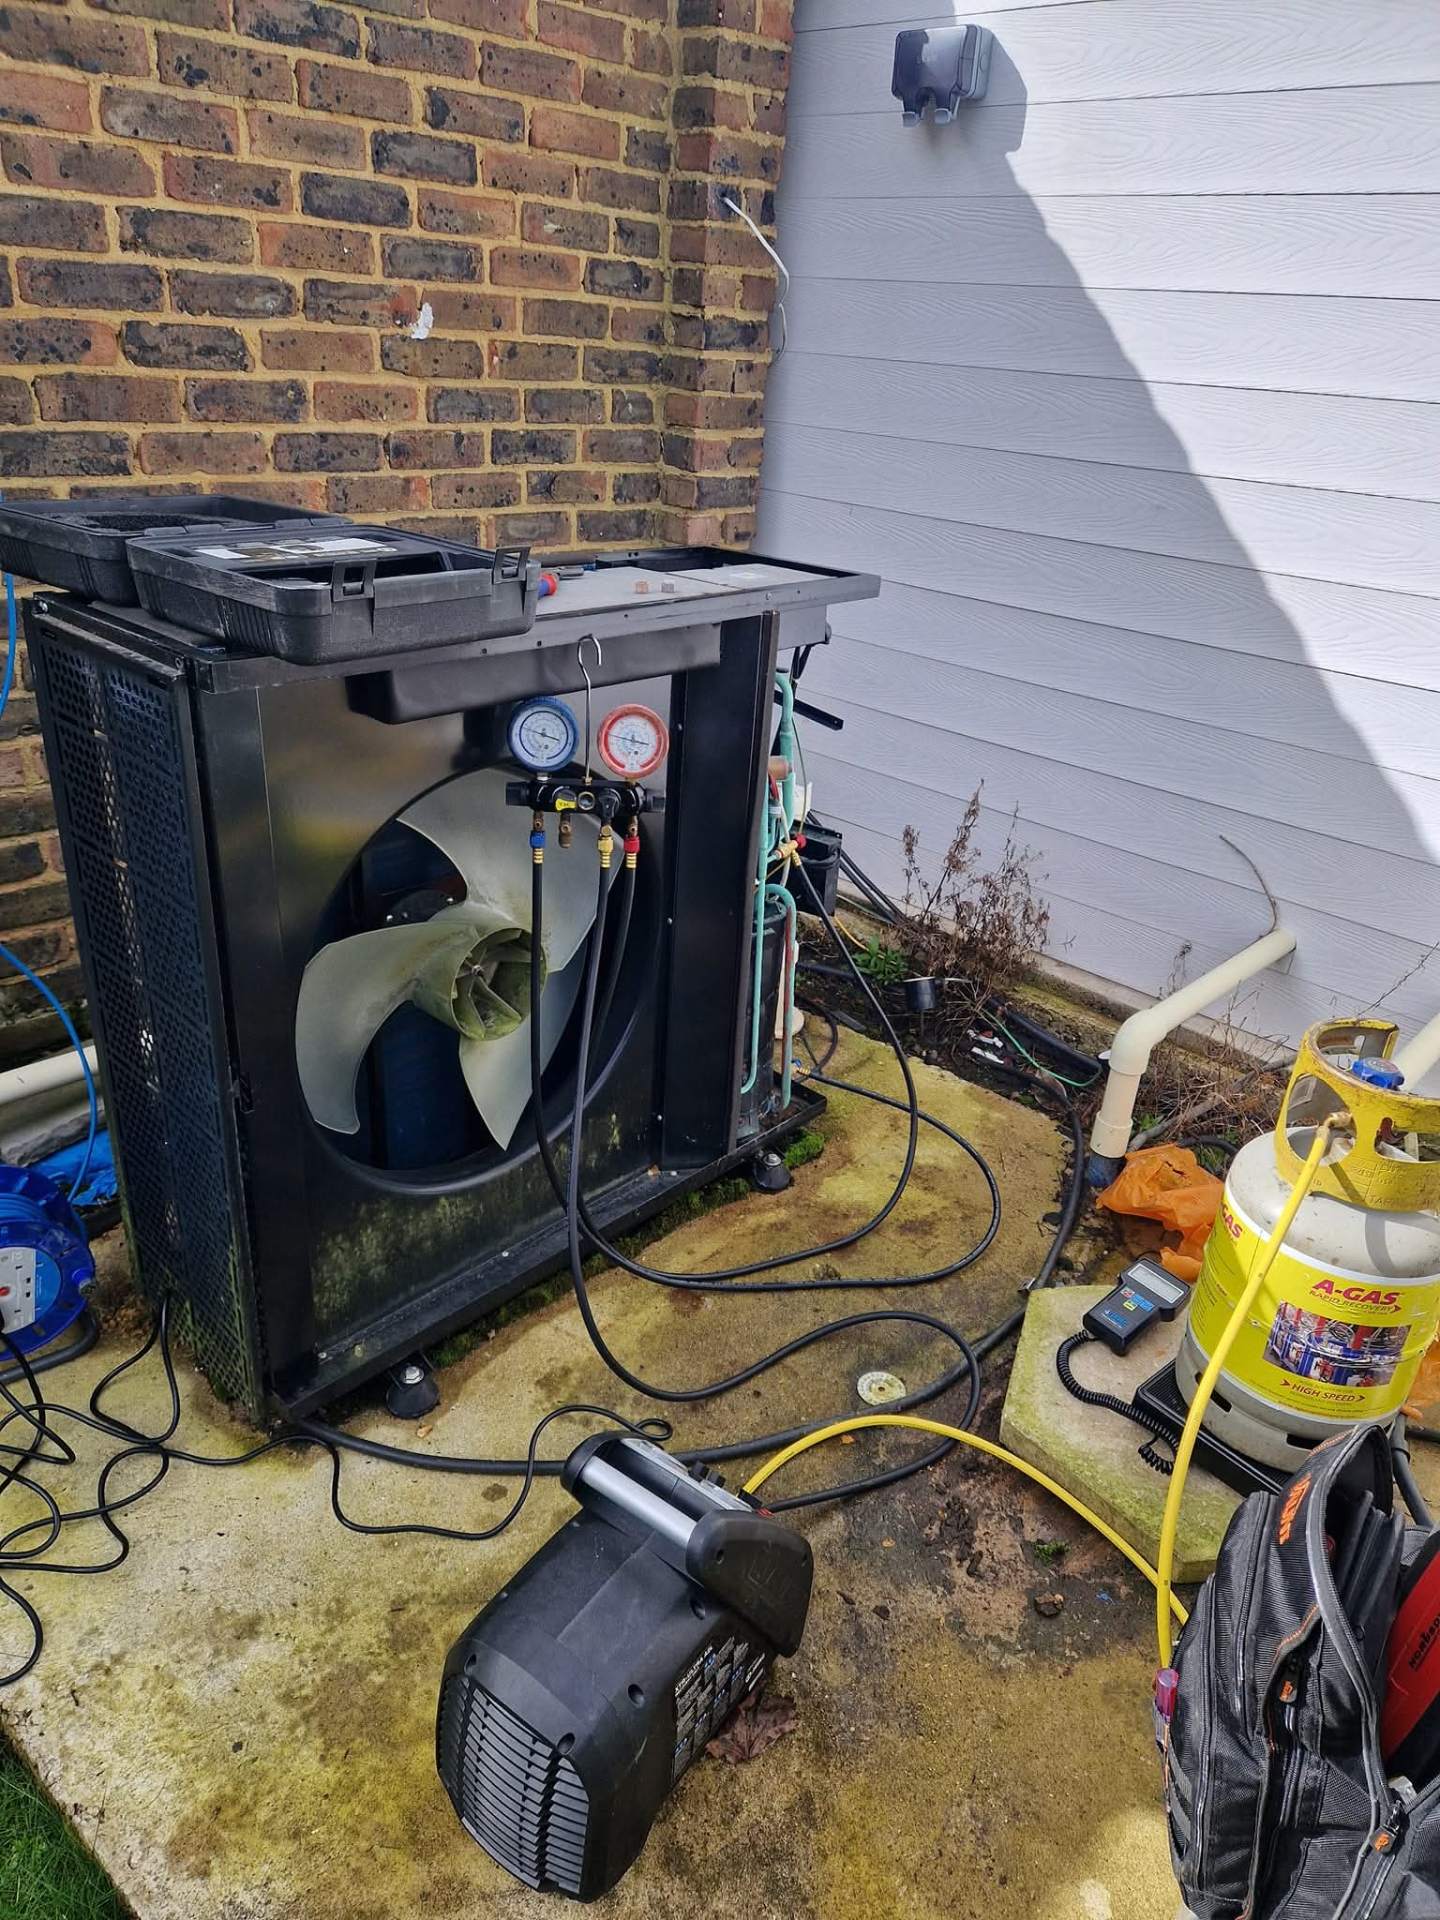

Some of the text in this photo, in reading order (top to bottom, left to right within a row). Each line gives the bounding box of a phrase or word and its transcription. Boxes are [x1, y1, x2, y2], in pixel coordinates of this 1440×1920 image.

[1309, 1289, 1340, 1304] RAPID
[1341, 1300, 1394, 1313] RECOVERY
[1312, 1279, 1401, 1306] A-GAS
[1291, 1383, 1320, 1398] HIGH
[1321, 1392, 1356, 1402] SPEED
